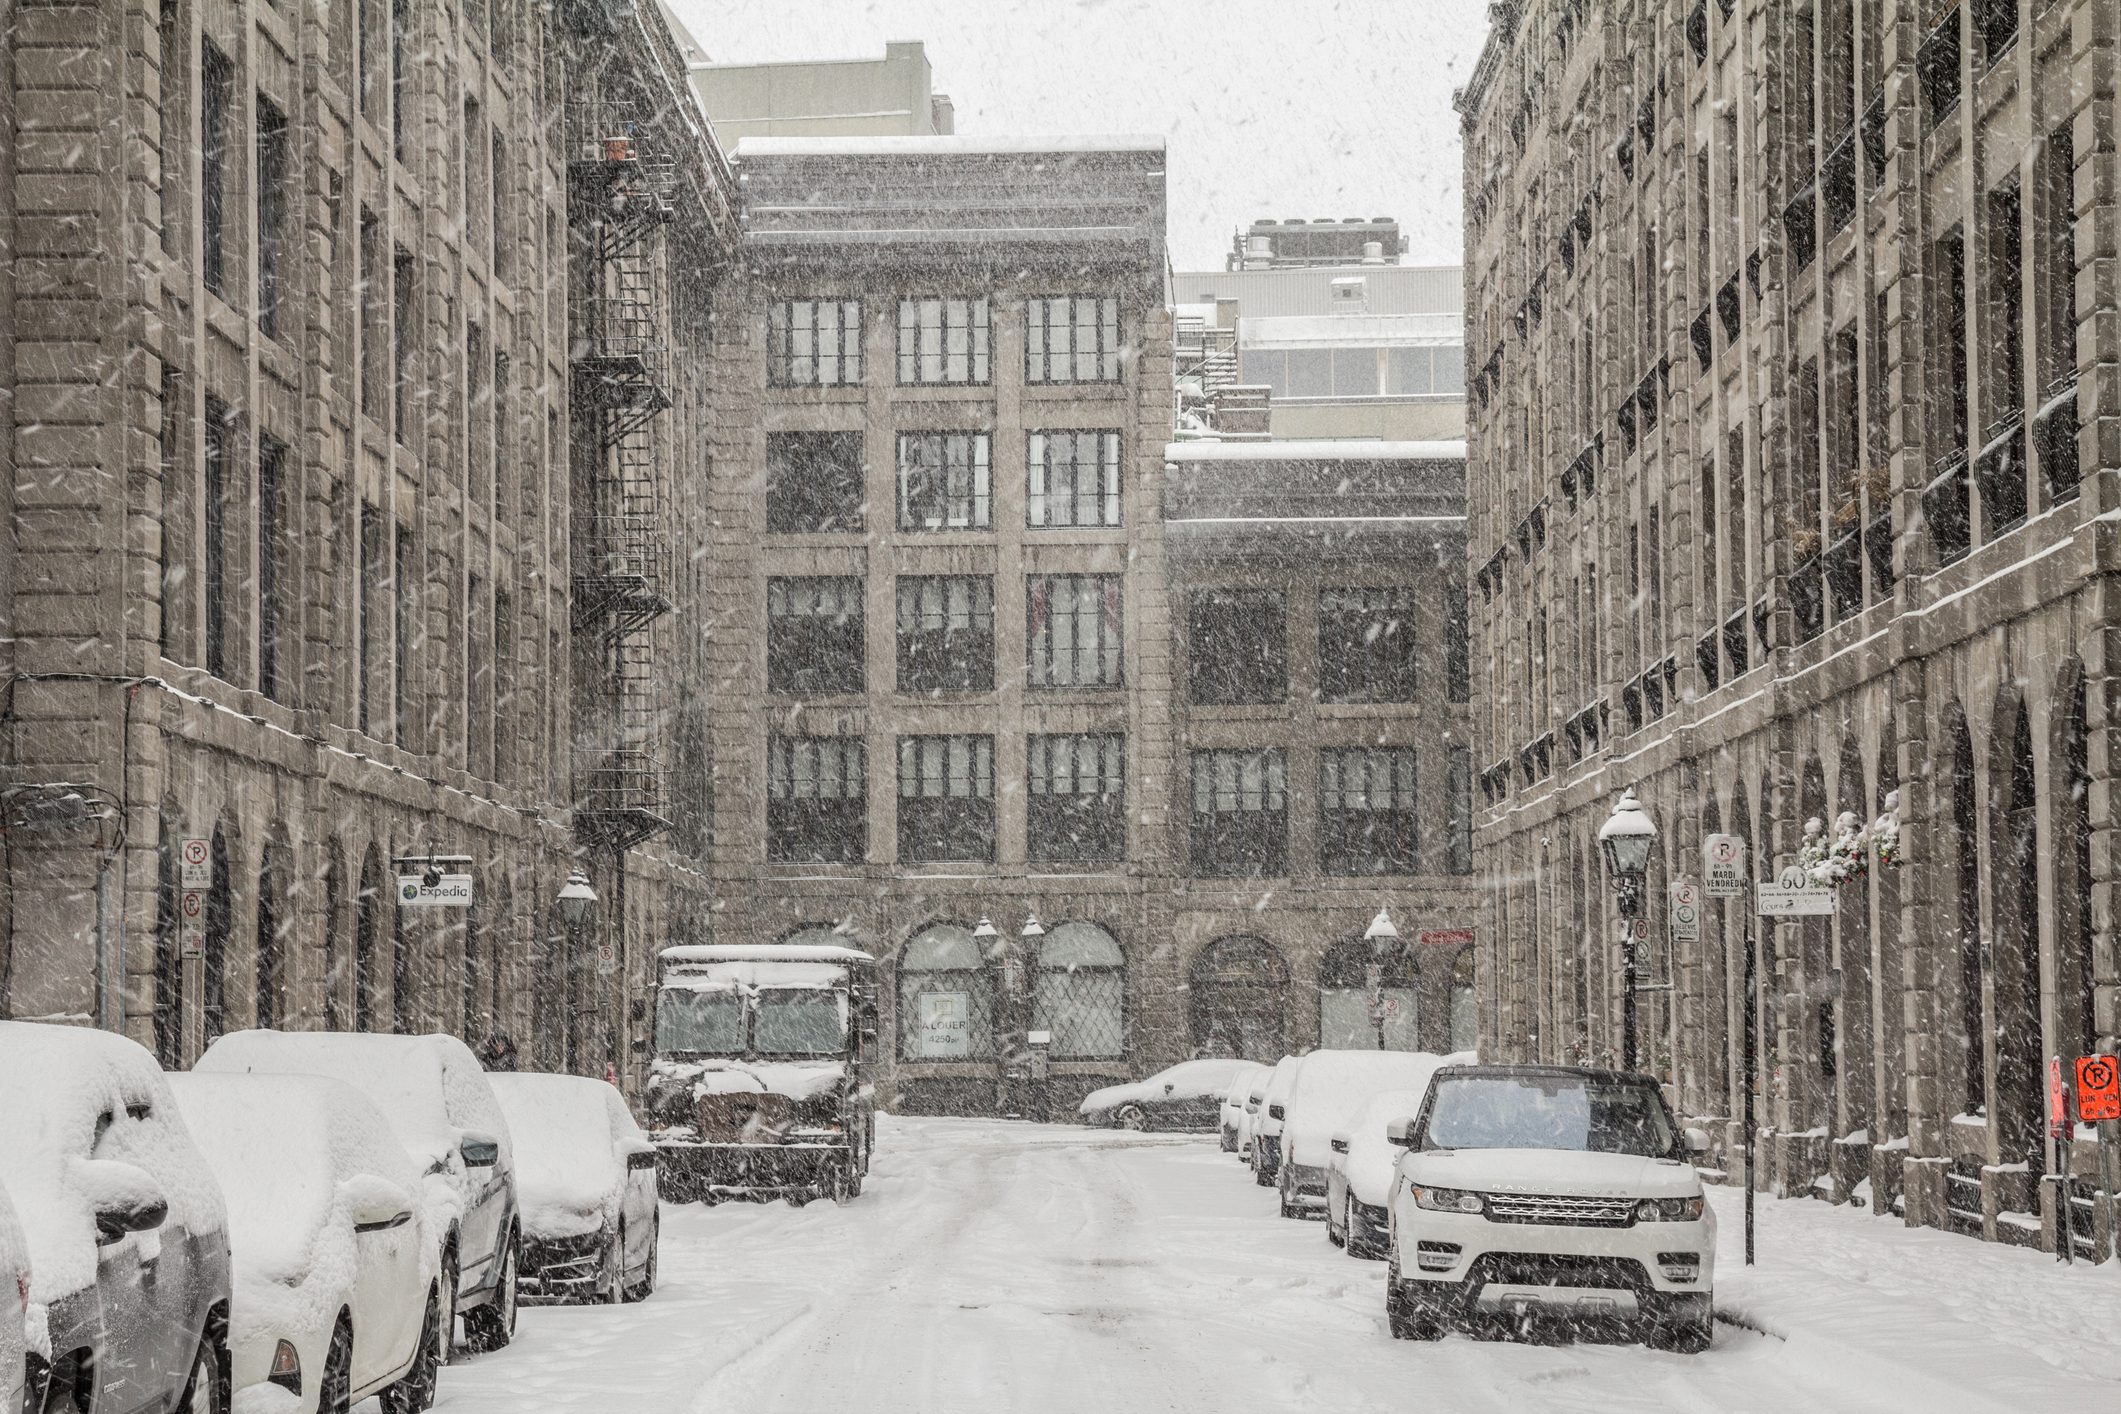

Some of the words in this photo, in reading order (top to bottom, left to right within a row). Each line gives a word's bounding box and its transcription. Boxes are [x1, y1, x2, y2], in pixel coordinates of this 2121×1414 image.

[1712, 871, 1735, 879] MARDI
[1706, 879, 1742, 888] VENDREDI
[1781, 872, 1806, 889] 60
[420, 884, 468, 899] Expedia
[931, 1021, 967, 1030] LOUER
[2080, 1094, 2096, 1103] LUN
[2103, 1093, 2118, 1102] VEN
[1492, 1184, 1554, 1193] RANGE
[1566, 1187, 1628, 1196] ROVER
